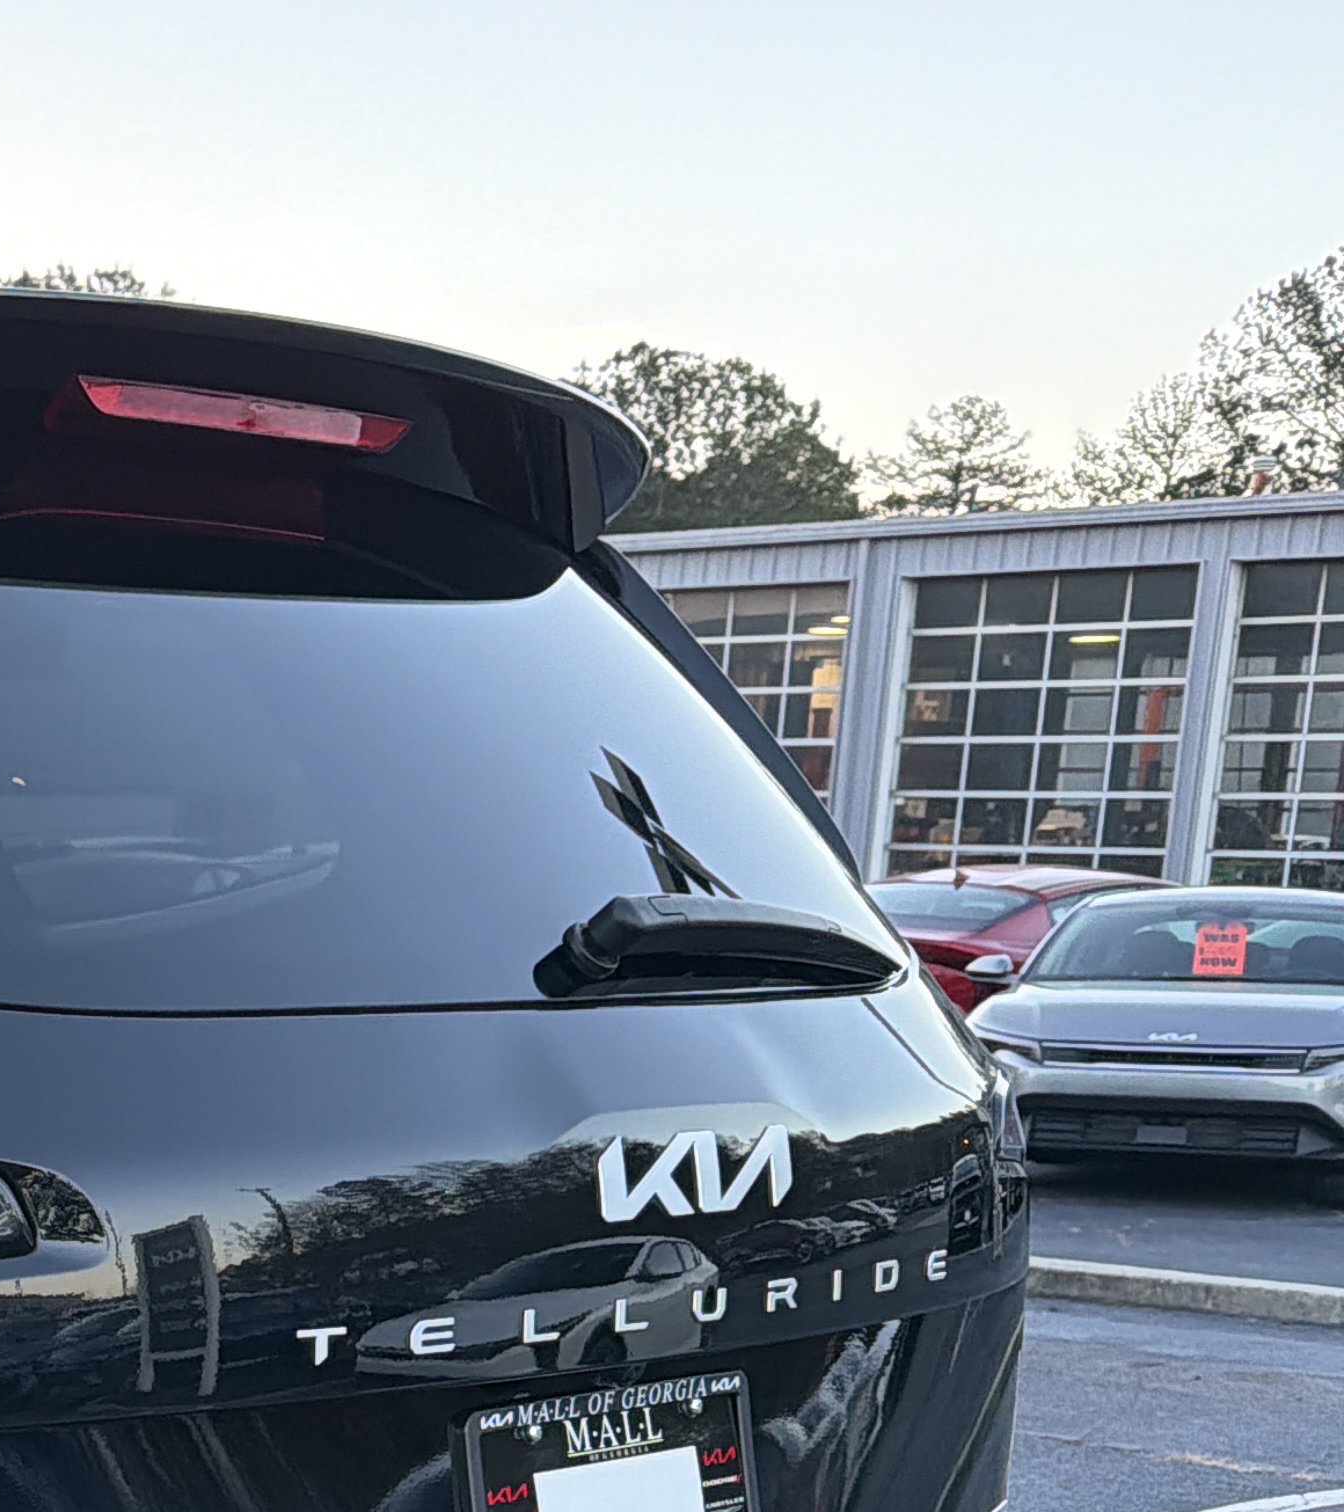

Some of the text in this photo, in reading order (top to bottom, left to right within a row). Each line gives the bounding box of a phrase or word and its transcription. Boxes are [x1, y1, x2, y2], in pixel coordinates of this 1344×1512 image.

[598, 1124, 793, 1223] KIA
[296, 1247, 949, 1366] TELLURIDE
[588, 1391, 616, 1416] OF
[621, 1377, 708, 1410] GEORGIA
[711, 1375, 740, 1393] KIA
[487, 1483, 529, 1506] KIA
